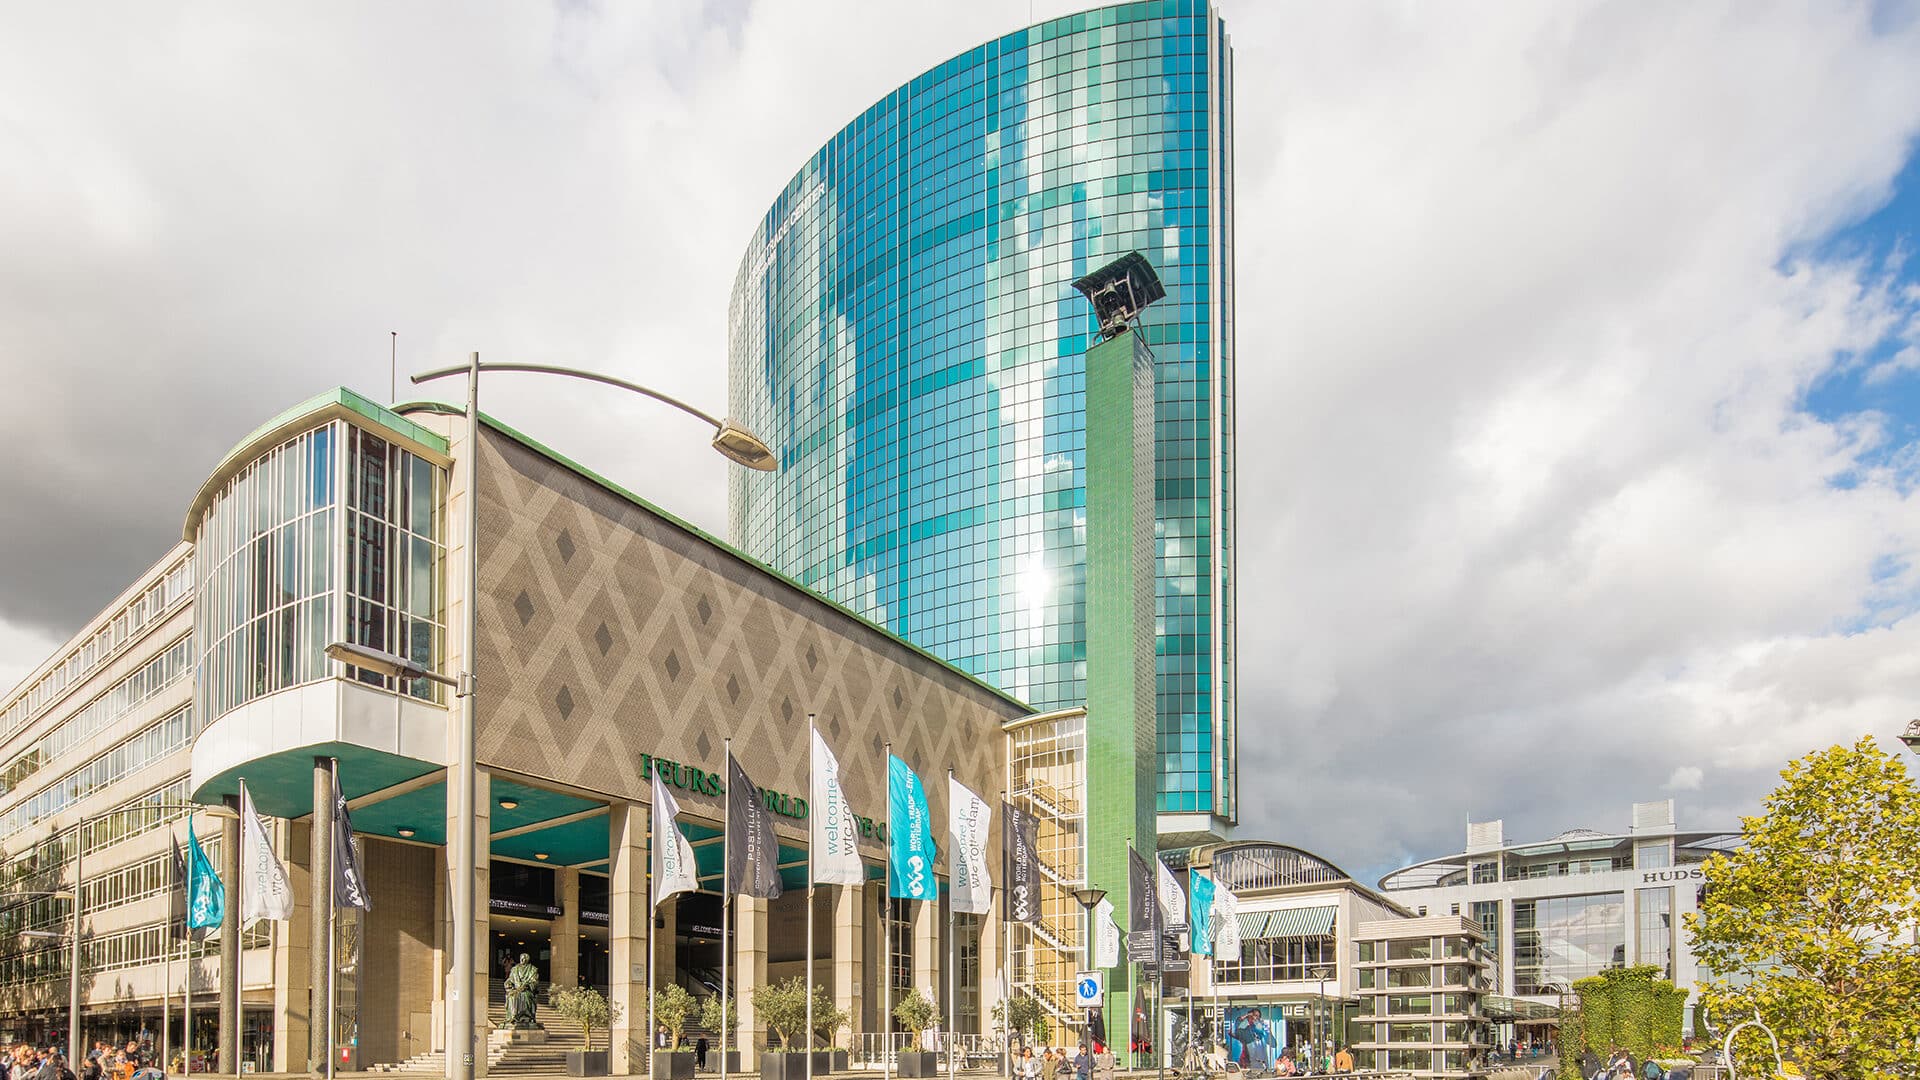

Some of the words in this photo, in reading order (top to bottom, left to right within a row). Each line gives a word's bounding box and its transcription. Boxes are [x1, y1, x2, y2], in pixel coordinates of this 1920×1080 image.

[824, 778, 838, 855] welcome
[968, 797, 980, 862] rotterdam
[957, 825, 968, 888] welcome
[1643, 869, 1713, 884] HUDS
[1283, 1006, 1304, 1016] WE
